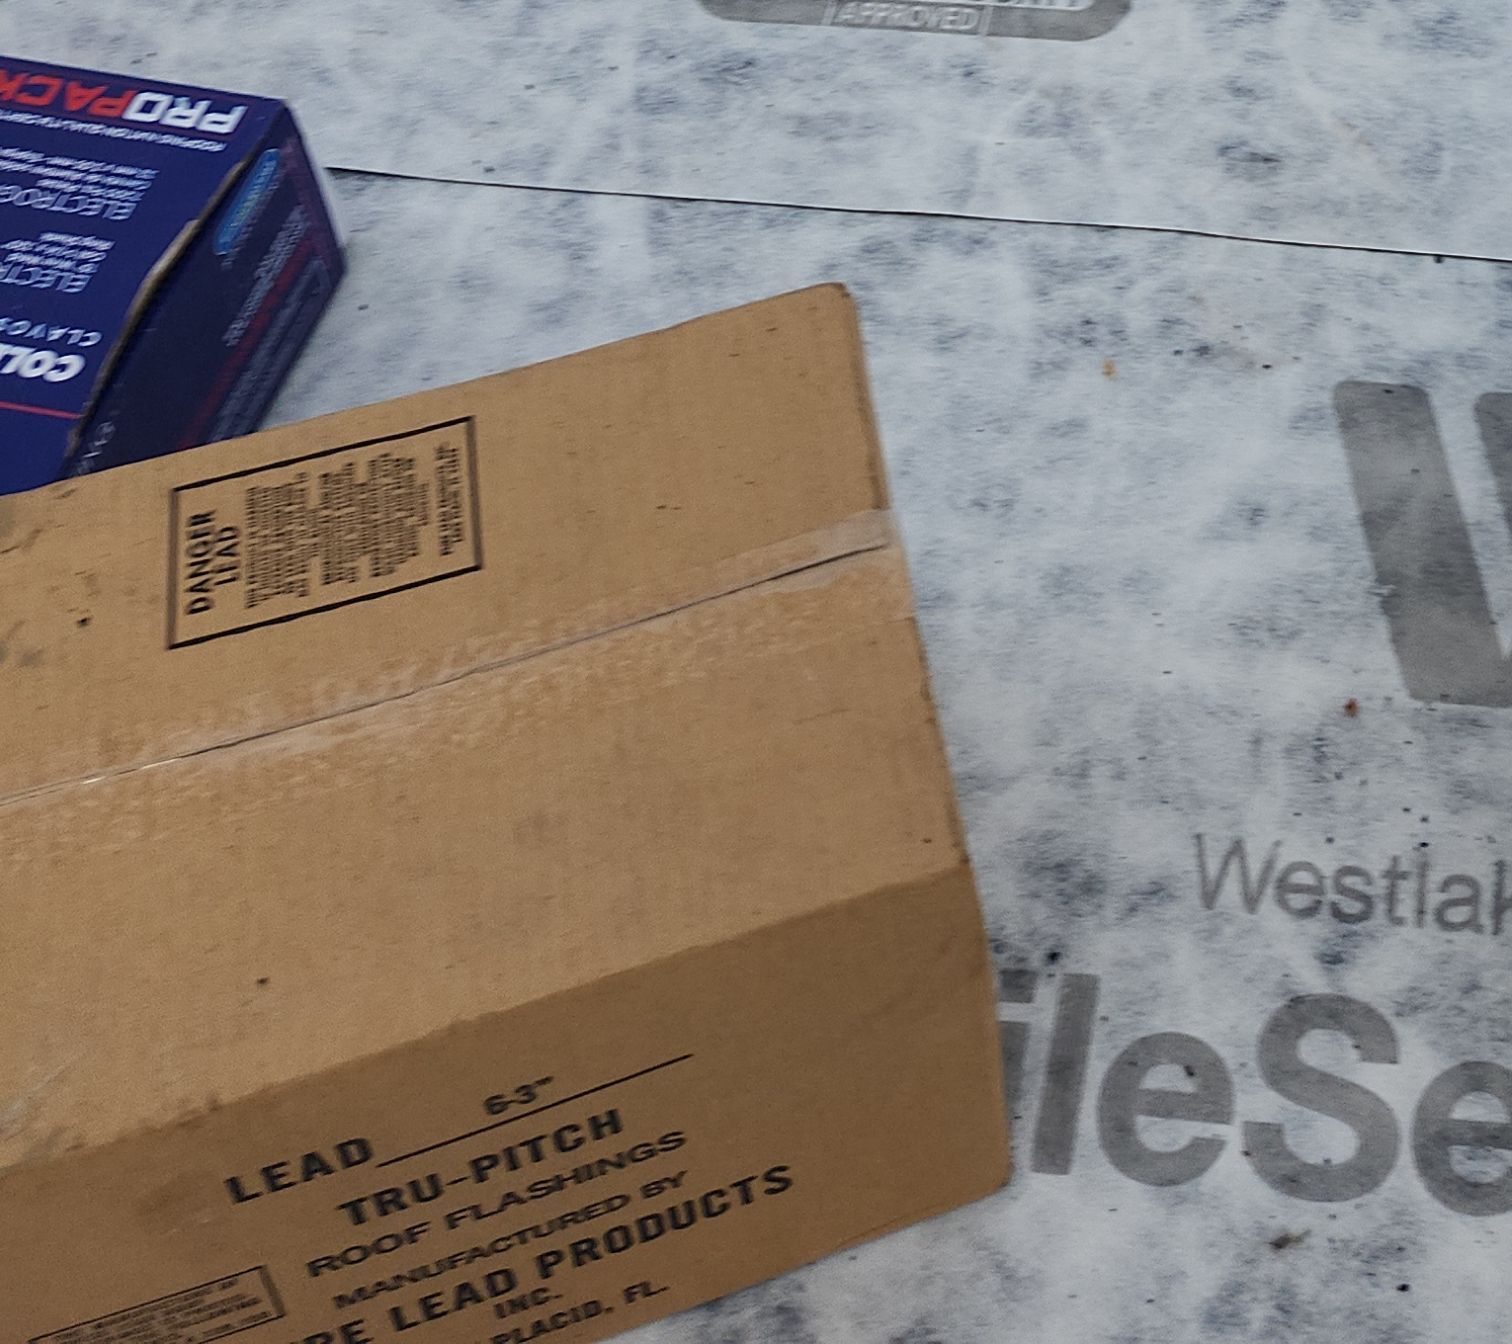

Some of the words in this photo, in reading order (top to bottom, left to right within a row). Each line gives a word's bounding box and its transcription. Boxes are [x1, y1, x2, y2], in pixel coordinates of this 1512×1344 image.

[213, 525, 240, 587] LEAD
[223, 1134, 375, 1206] LEAD
[306, 1221, 431, 1277] ROOF
[445, 1130, 687, 1230] FLASHINGS
[336, 1107, 624, 1227] TRU-PITCH
[333, 1194, 632, 1310] MANUFACTURED
[639, 1170, 687, 1199] BY
[388, 1267, 518, 1332] LEAD
[536, 1164, 793, 1279] PRODUCTS
